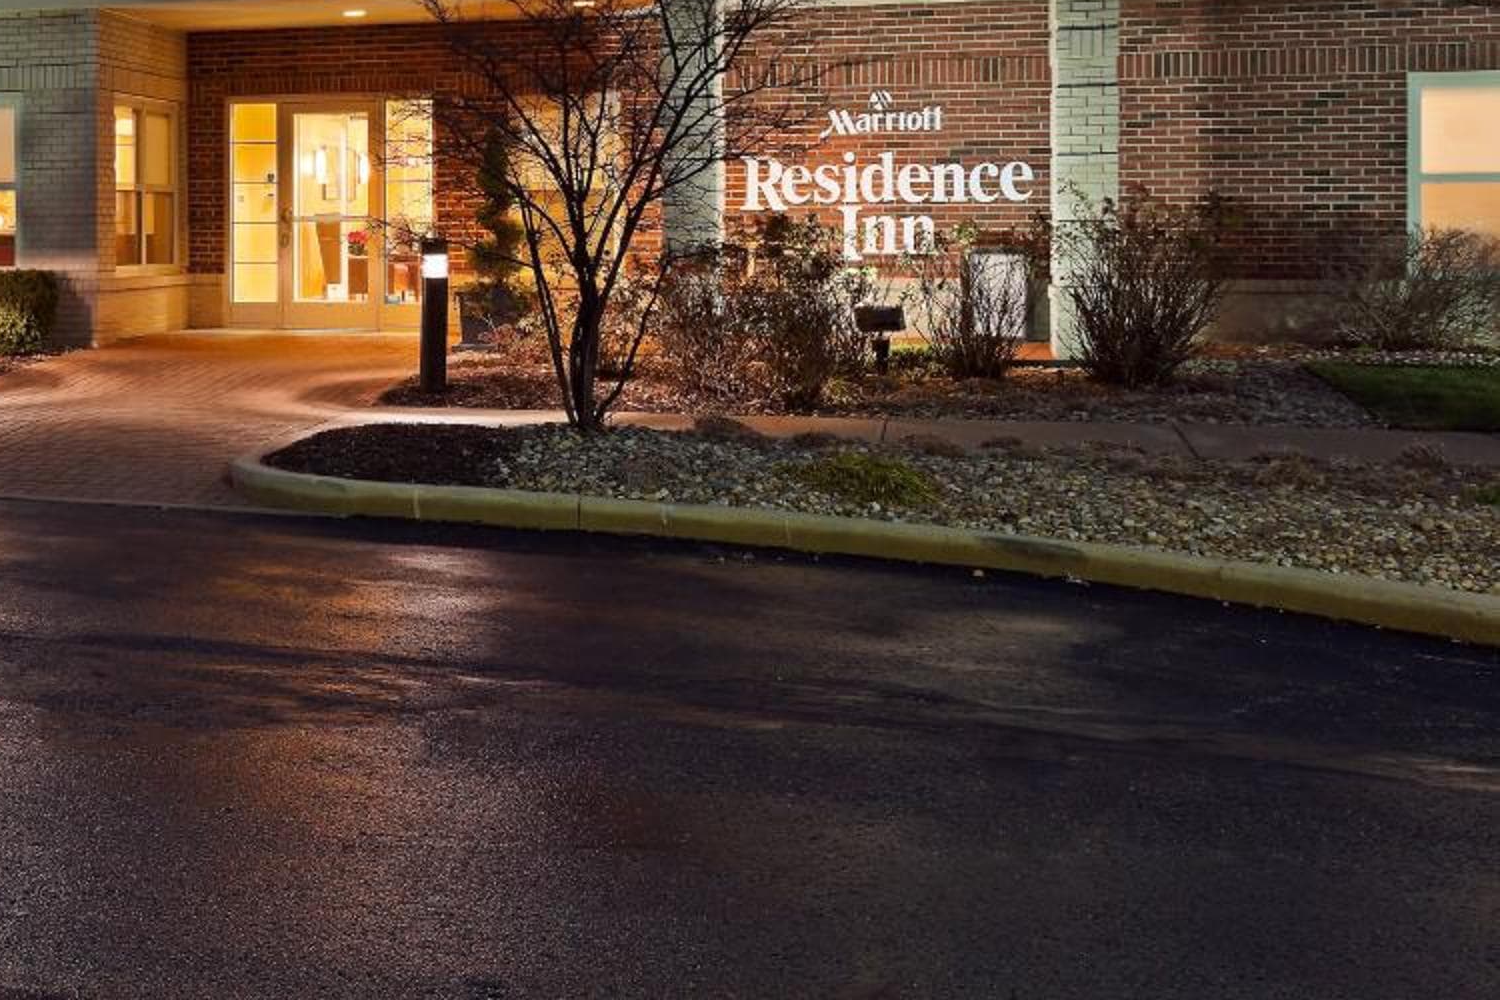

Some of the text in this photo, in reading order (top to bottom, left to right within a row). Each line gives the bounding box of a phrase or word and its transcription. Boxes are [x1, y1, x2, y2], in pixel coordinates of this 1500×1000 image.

[820, 106, 943, 138] Marriott
[740, 151, 1034, 211] Residence
[839, 204, 935, 261] Inn
